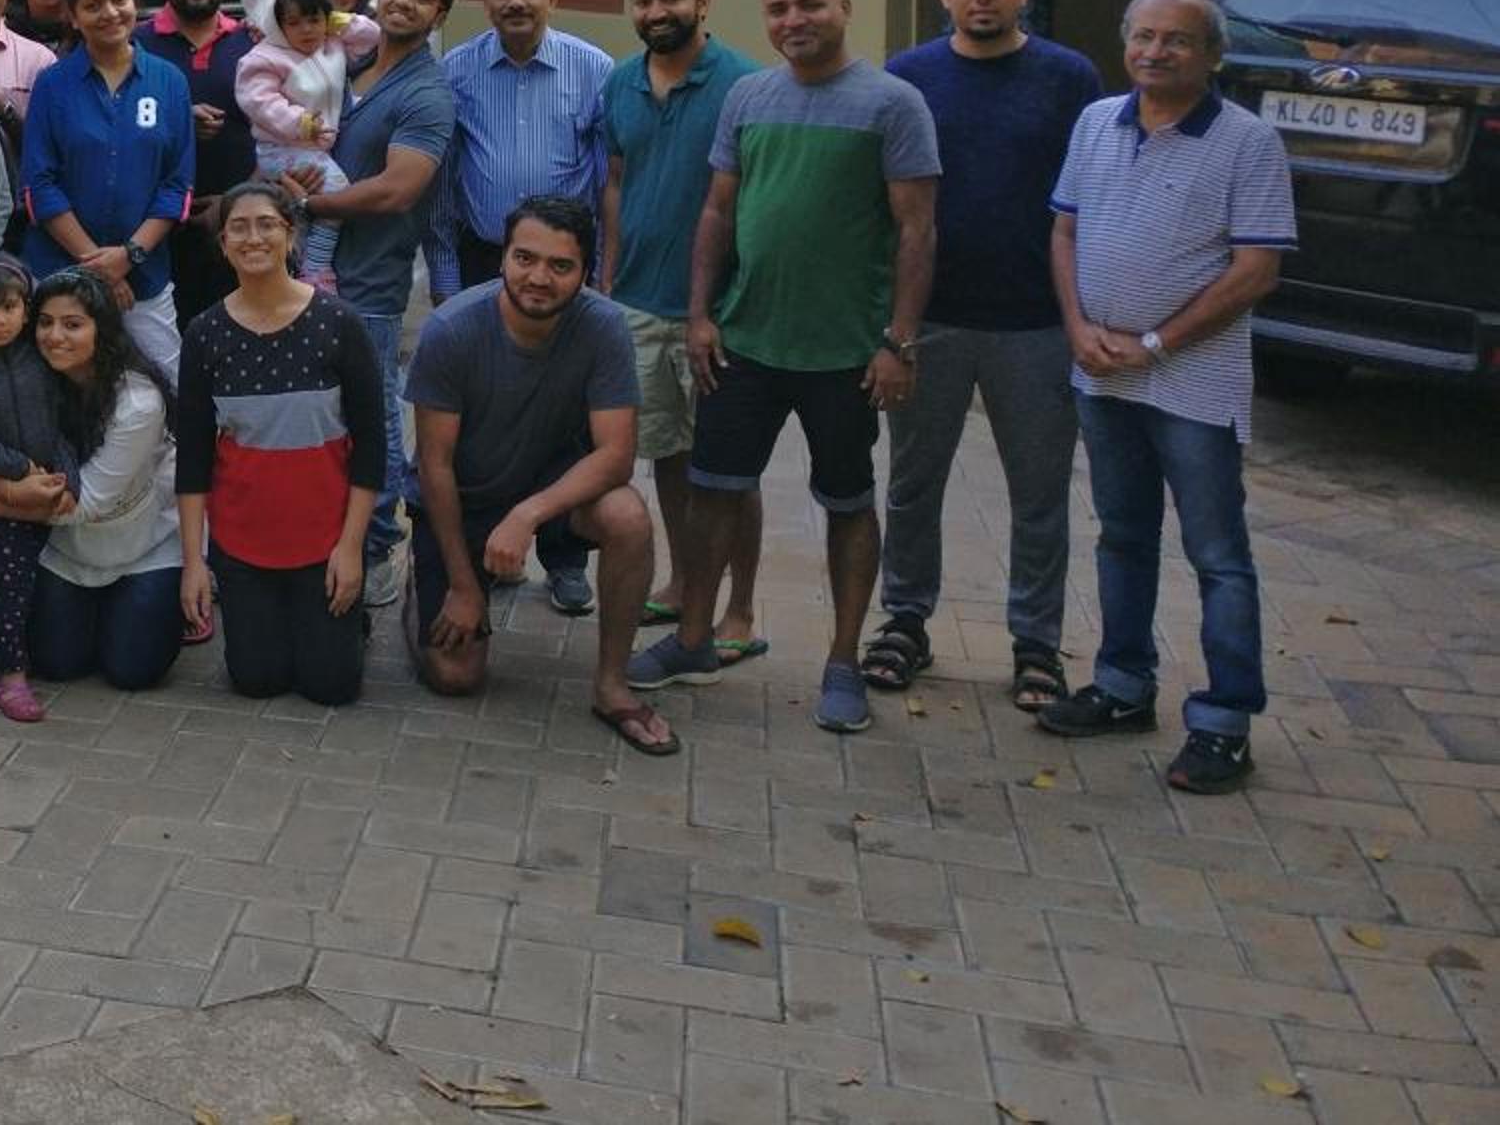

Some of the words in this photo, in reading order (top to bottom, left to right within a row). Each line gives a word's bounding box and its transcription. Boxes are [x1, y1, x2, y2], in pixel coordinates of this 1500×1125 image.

[136, 96, 158, 127] 8
[1276, 98, 1301, 123] KL
[1308, 103, 1336, 127] 40
[1345, 106, 1359, 129] C
[1371, 109, 1417, 136] 849
